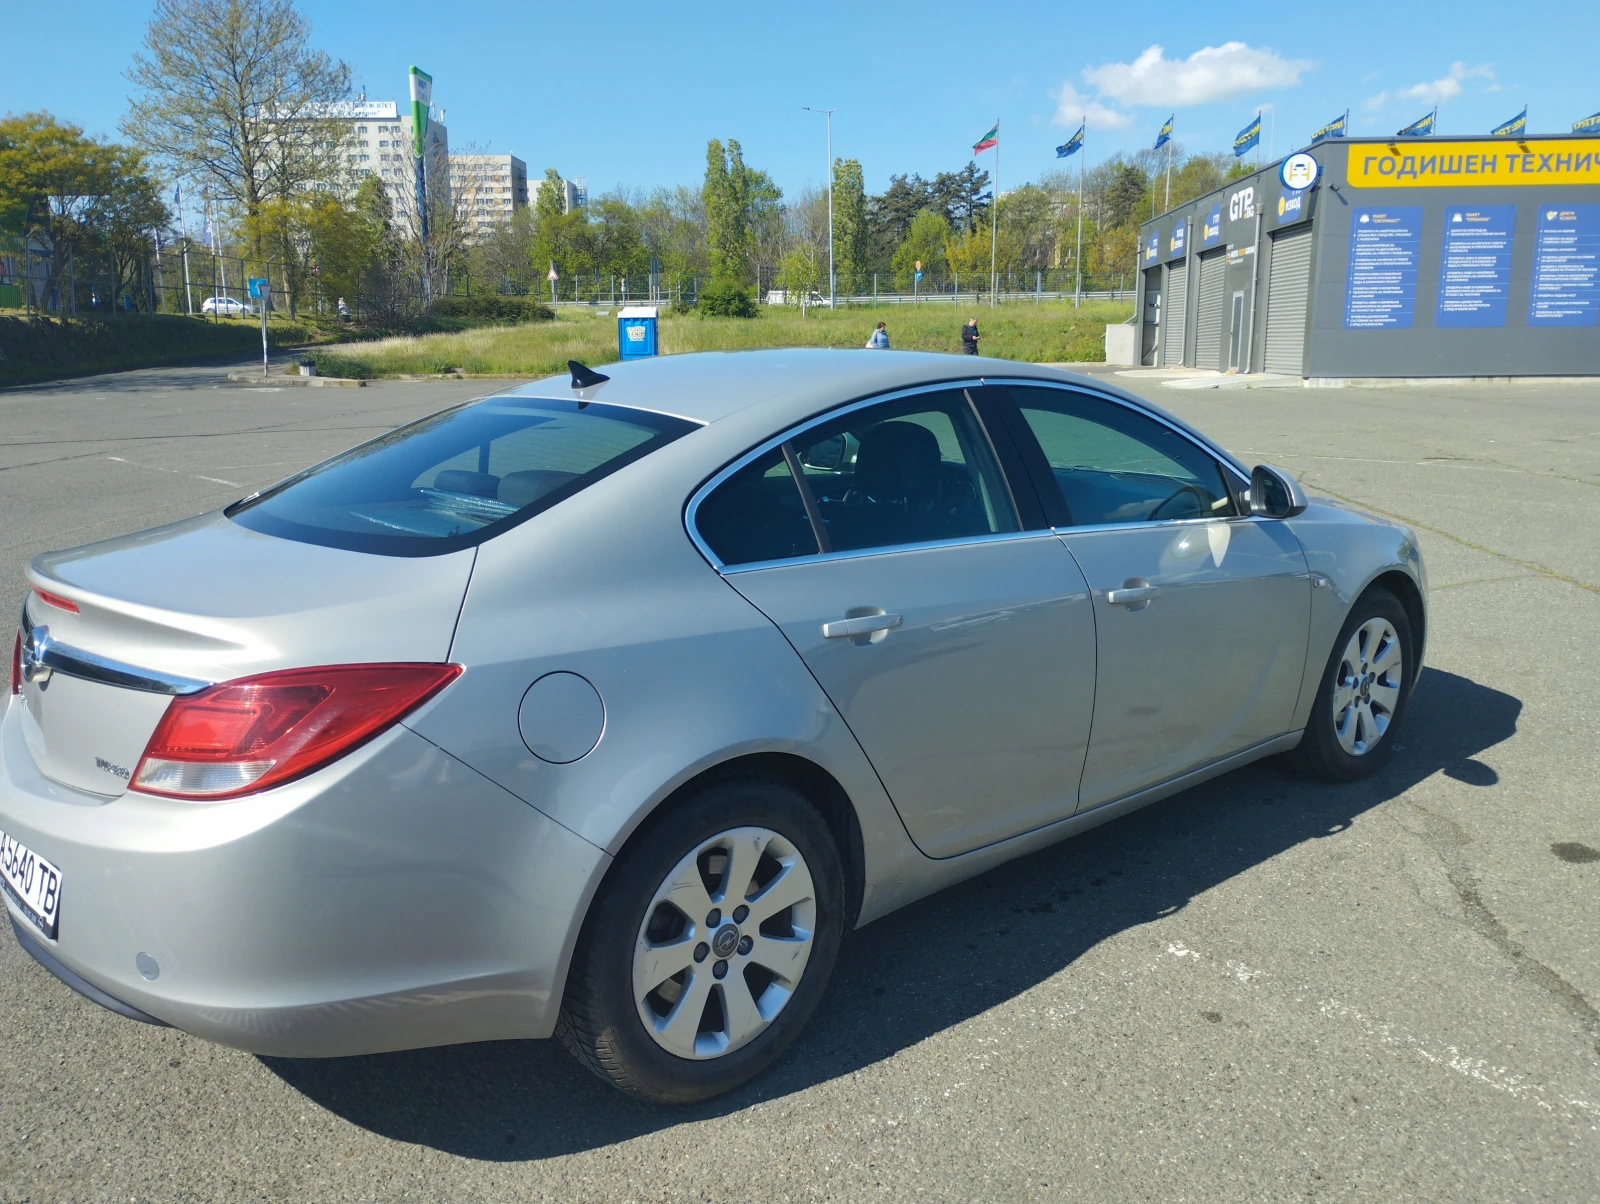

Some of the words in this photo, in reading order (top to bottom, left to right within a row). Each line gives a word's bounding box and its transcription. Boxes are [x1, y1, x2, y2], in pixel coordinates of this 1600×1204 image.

[1363, 155, 1498, 179] ГОДИШЕН
[1229, 187, 1254, 221] GTP
[39, 861, 57, 915] TB
